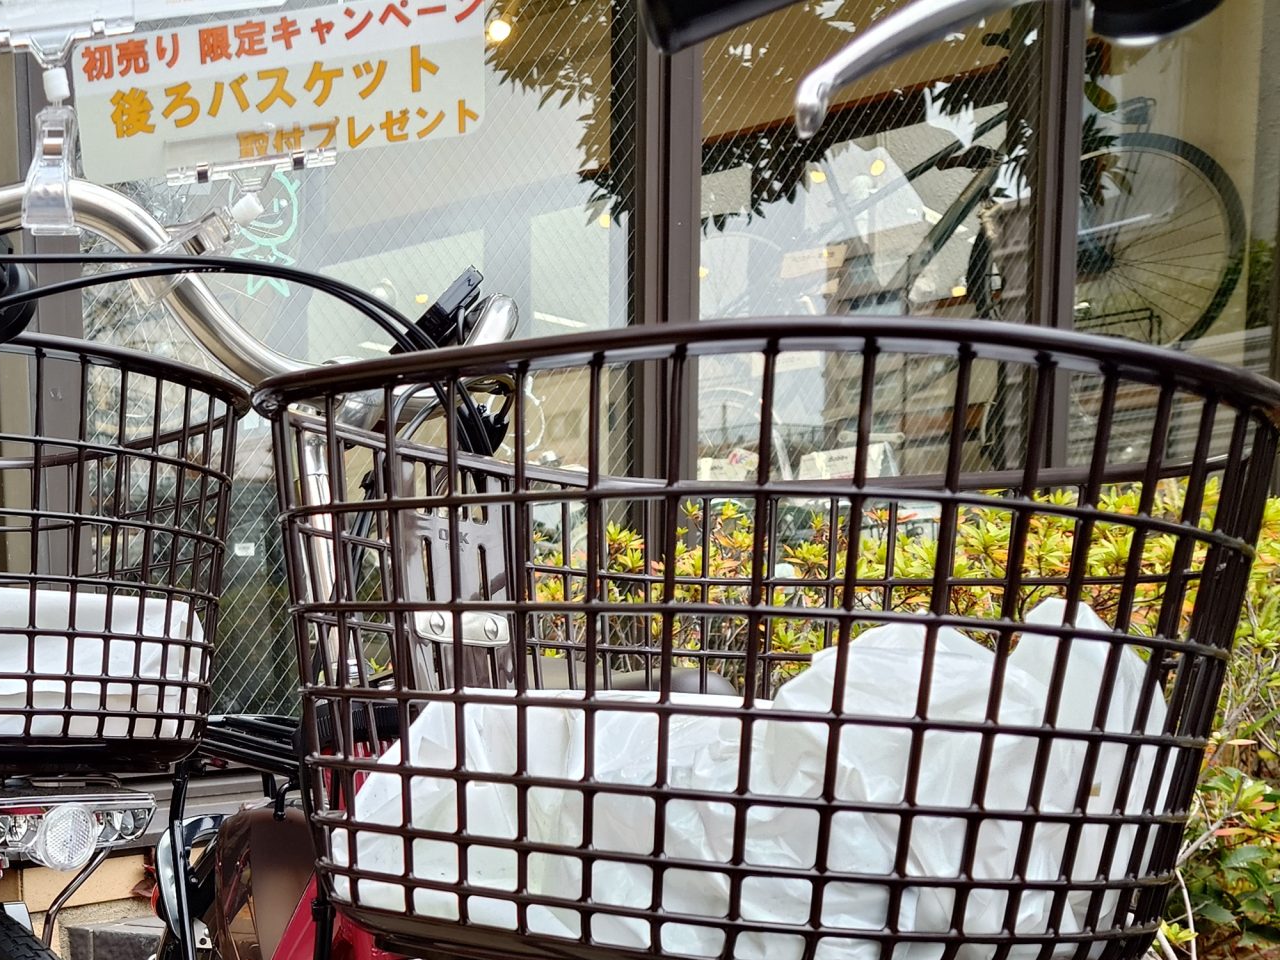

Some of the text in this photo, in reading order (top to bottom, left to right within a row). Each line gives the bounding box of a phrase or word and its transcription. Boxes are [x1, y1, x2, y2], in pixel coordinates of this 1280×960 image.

[81, 32, 180, 83] 初売り
[110, 44, 440, 138] 後ろバスケット
[438, 528, 470, 544] OK
